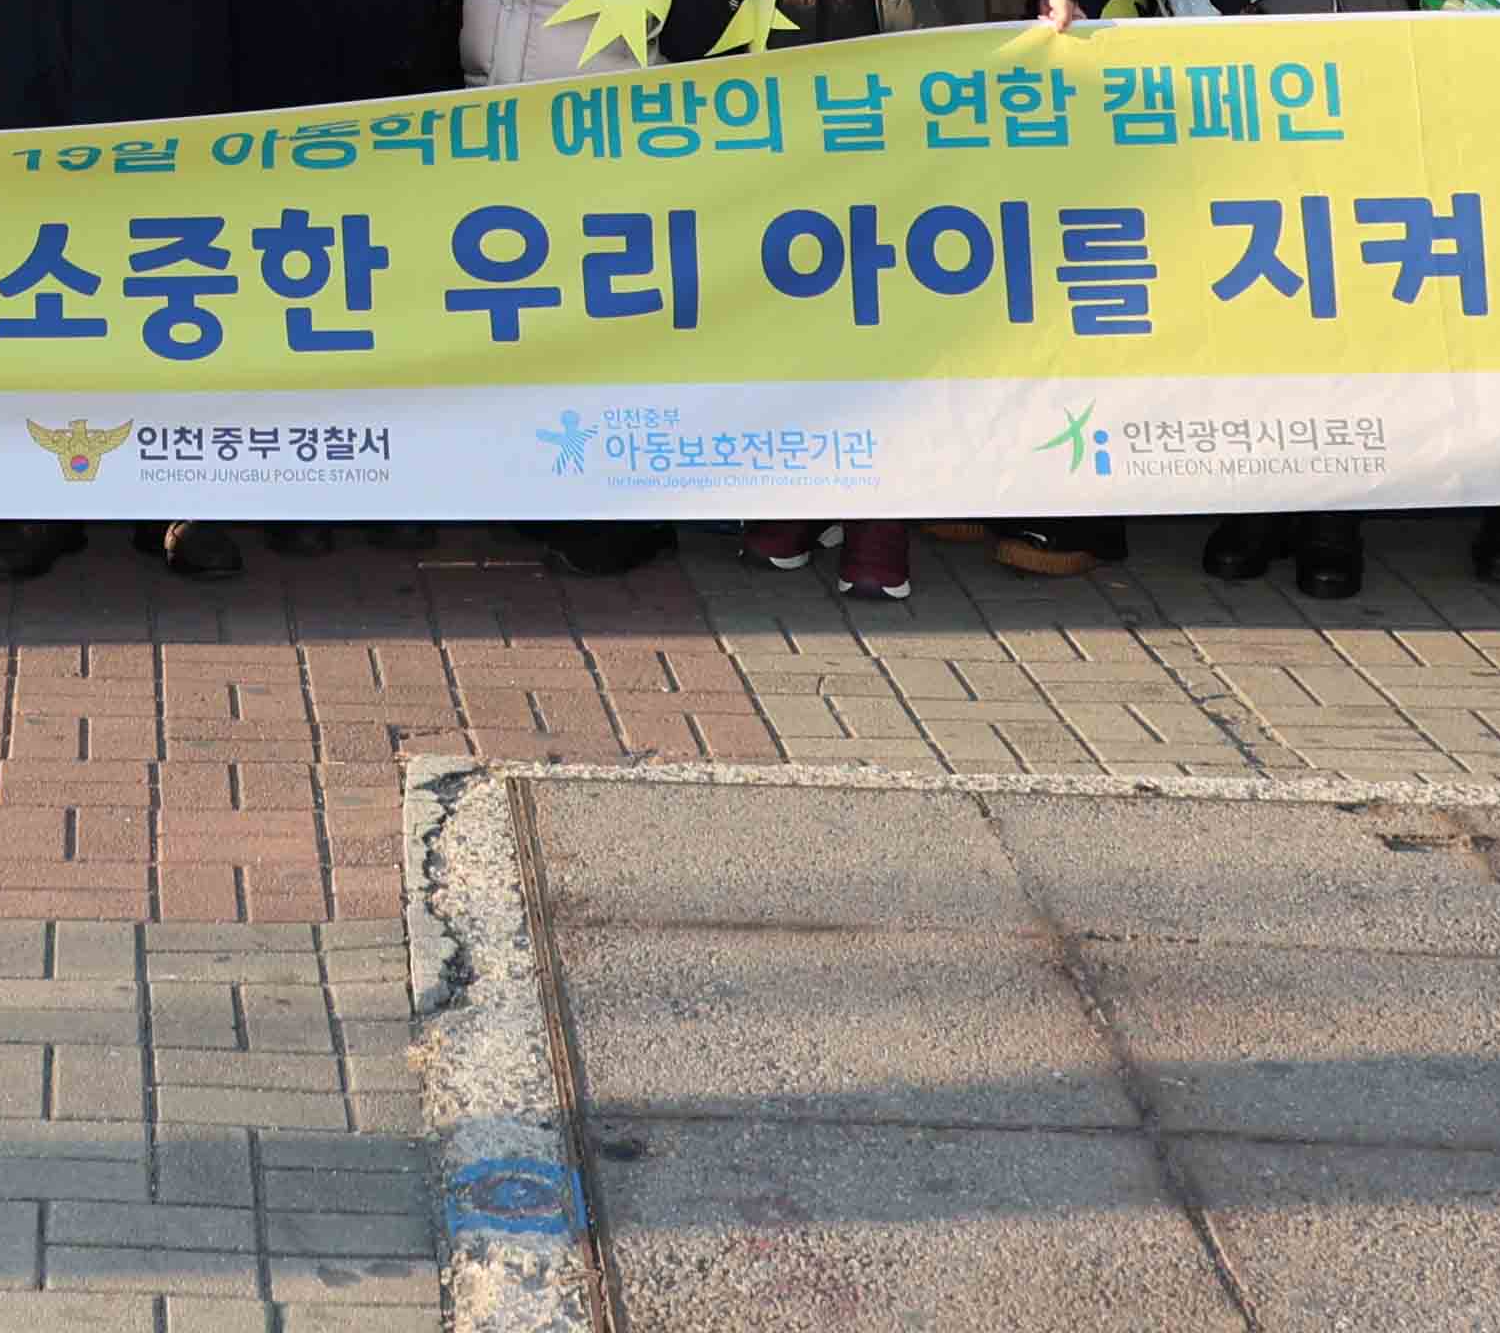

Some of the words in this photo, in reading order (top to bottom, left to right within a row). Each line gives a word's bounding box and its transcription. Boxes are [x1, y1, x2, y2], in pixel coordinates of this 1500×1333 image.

[209, 98, 524, 172] 아동학대
[550, 79, 786, 160] 예방의
[811, 70, 894, 154] 날
[918, 65, 1078, 151] 연합
[1101, 61, 1346, 146] 캠페인
[443, 204, 699, 343] 우리
[760, 199, 1158, 336] 아이를
[603, 406, 682, 430] 인천중부
[1123, 417, 1387, 454] 인천광역시의료원
[604, 428, 879, 473] 아동보호전문기관
[1127, 460, 1210, 477] INCHEON
[1219, 458, 1305, 475] MEDICAL
[1311, 456, 1387, 474] CENTER
[140, 467, 206, 483] INCHEON
[210, 467, 272, 483] JUNGBU
[274, 467, 325, 483] POLICE
[329, 467, 391, 483] STATION
